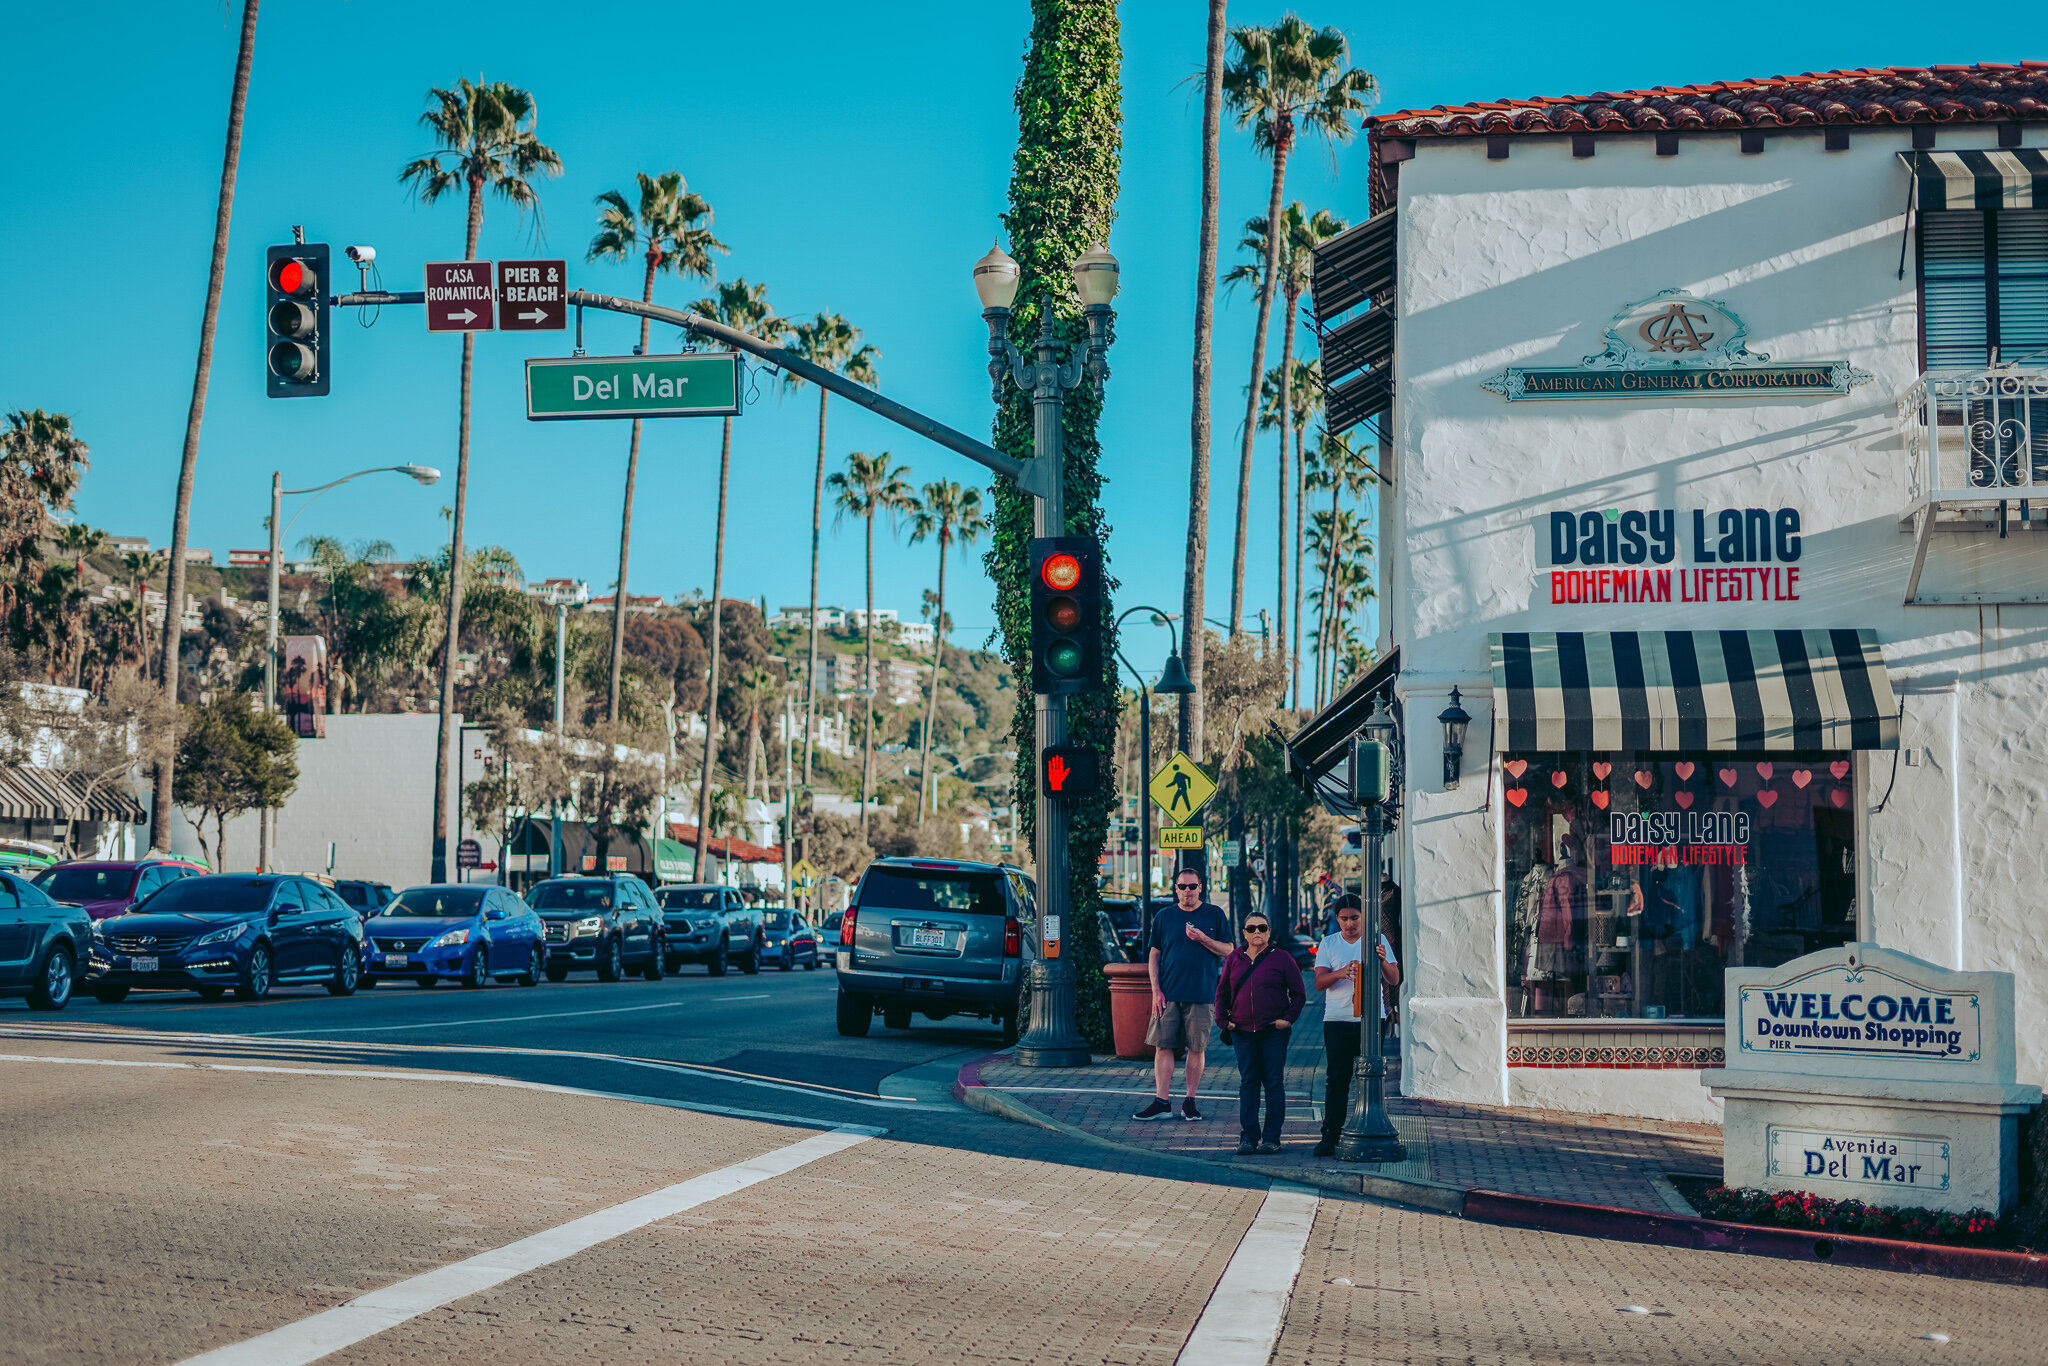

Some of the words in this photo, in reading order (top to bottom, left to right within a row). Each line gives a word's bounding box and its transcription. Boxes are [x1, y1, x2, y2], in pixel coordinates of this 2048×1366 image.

[445, 269, 474, 283] CASA
[505, 267, 540, 283] PIER
[547, 267, 559, 283] &
[429, 286, 491, 301] ROMANTICA
[507, 286, 558, 302] BEACH
[574, 374, 619, 400] Del
[633, 372, 689, 399] Mar
[1525, 374, 1615, 392] AMERICAN
[1621, 372, 1703, 391] GENERAL
[1707, 370, 1831, 389] CORPORATION
[1550, 508, 1675, 566] Daisy
[1693, 507, 1801, 564] Lane
[1551, 569, 1671, 605] BOHEMIAN
[1680, 567, 1801, 602] LIFESTYLE
[1164, 832, 1198, 843] AHEAD
[1610, 811, 1681, 845] Daisy
[1688, 811, 1750, 845] Lane
[1611, 845, 1678, 865] BOHEMIAN
[1682, 845, 1748, 865] LIFESTYLE
[1763, 992, 1956, 1024] WELCOME
[1758, 1018, 1861, 1041] Downtown
[1865, 1022, 1962, 1054] Shopping
[1769, 1039, 1792, 1050] PIER
[1822, 1137, 1898, 1156] Avenida
[1804, 1150, 1849, 1179] Del
[1862, 1155, 1922, 1184] Mar
